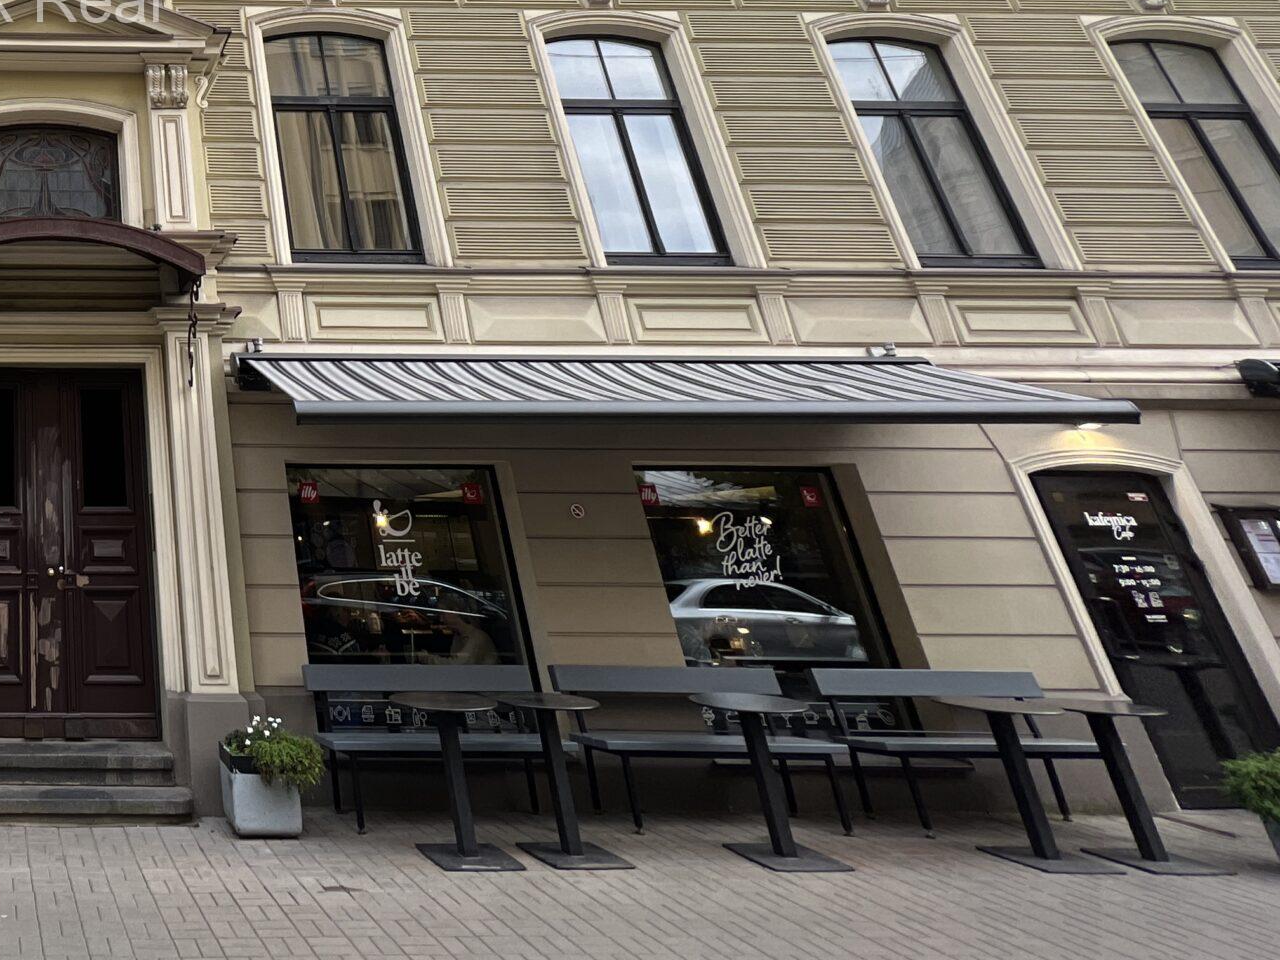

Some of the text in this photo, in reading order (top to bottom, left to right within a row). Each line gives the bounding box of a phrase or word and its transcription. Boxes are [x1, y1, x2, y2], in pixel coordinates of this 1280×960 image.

[301, 485, 317, 500] illy
[641, 488, 658, 504] illy
[711, 511, 770, 552] Better
[378, 544, 423, 567] latte
[737, 535, 773, 562] latte
[721, 551, 767, 576] than
[735, 555, 784, 590] never!
[393, 573, 421, 596] be
